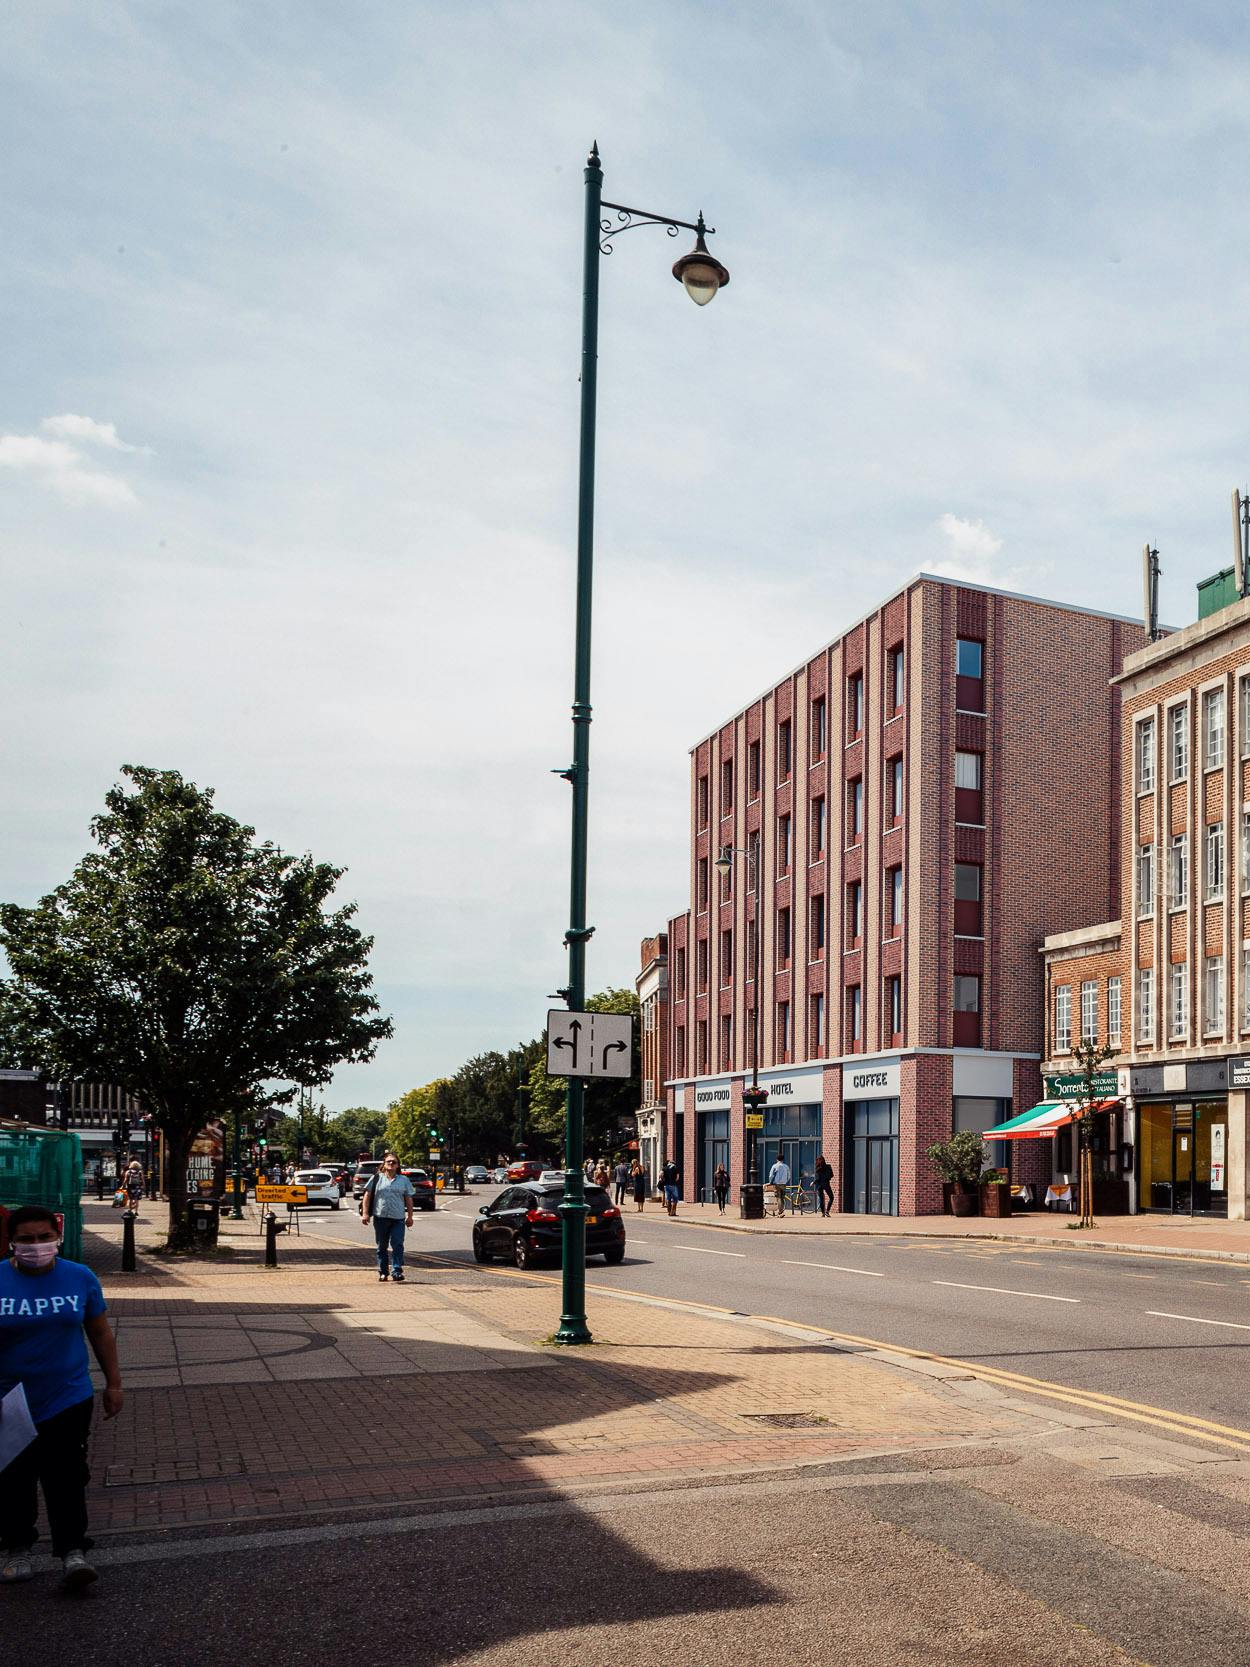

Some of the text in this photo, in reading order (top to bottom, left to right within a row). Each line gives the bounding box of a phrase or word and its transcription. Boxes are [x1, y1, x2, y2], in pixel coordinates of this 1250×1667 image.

[853, 1072, 888, 1089] COFFEE
[1233, 1074, 1250, 1084] ESSEX
[697, 1089, 730, 1103] GOOD FOOD
[770, 1083, 794, 1096] HOTEL
[0, 1295, 79, 1316] HAPPY
